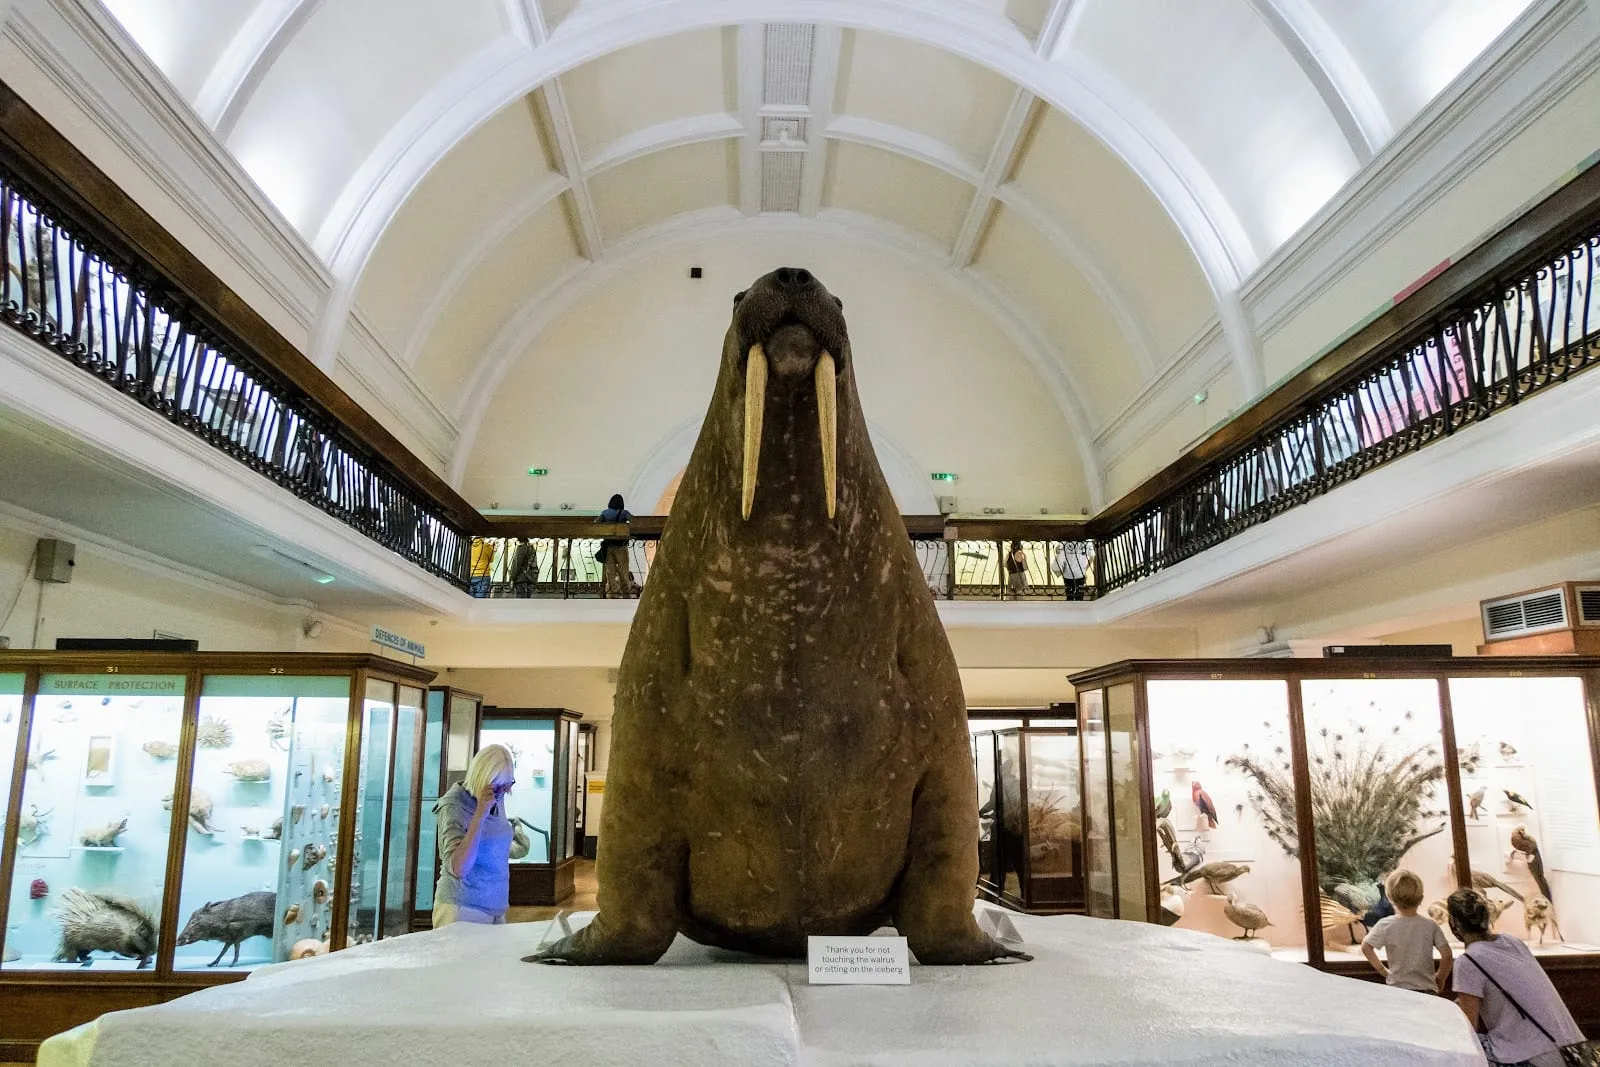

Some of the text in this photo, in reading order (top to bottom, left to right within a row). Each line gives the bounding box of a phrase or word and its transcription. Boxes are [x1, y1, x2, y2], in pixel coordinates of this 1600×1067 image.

[375, 628, 399, 646] DEFENCES
[407, 640, 425, 655] ANIMALS
[53, 680, 176, 690] SURFACE PROTECTION
[825, 945, 891, 955] Thank you for not
[822, 956, 895, 965] touching the walrus
[824, 966, 849, 975] sitting
[874, 966, 904, 975] iceberg
